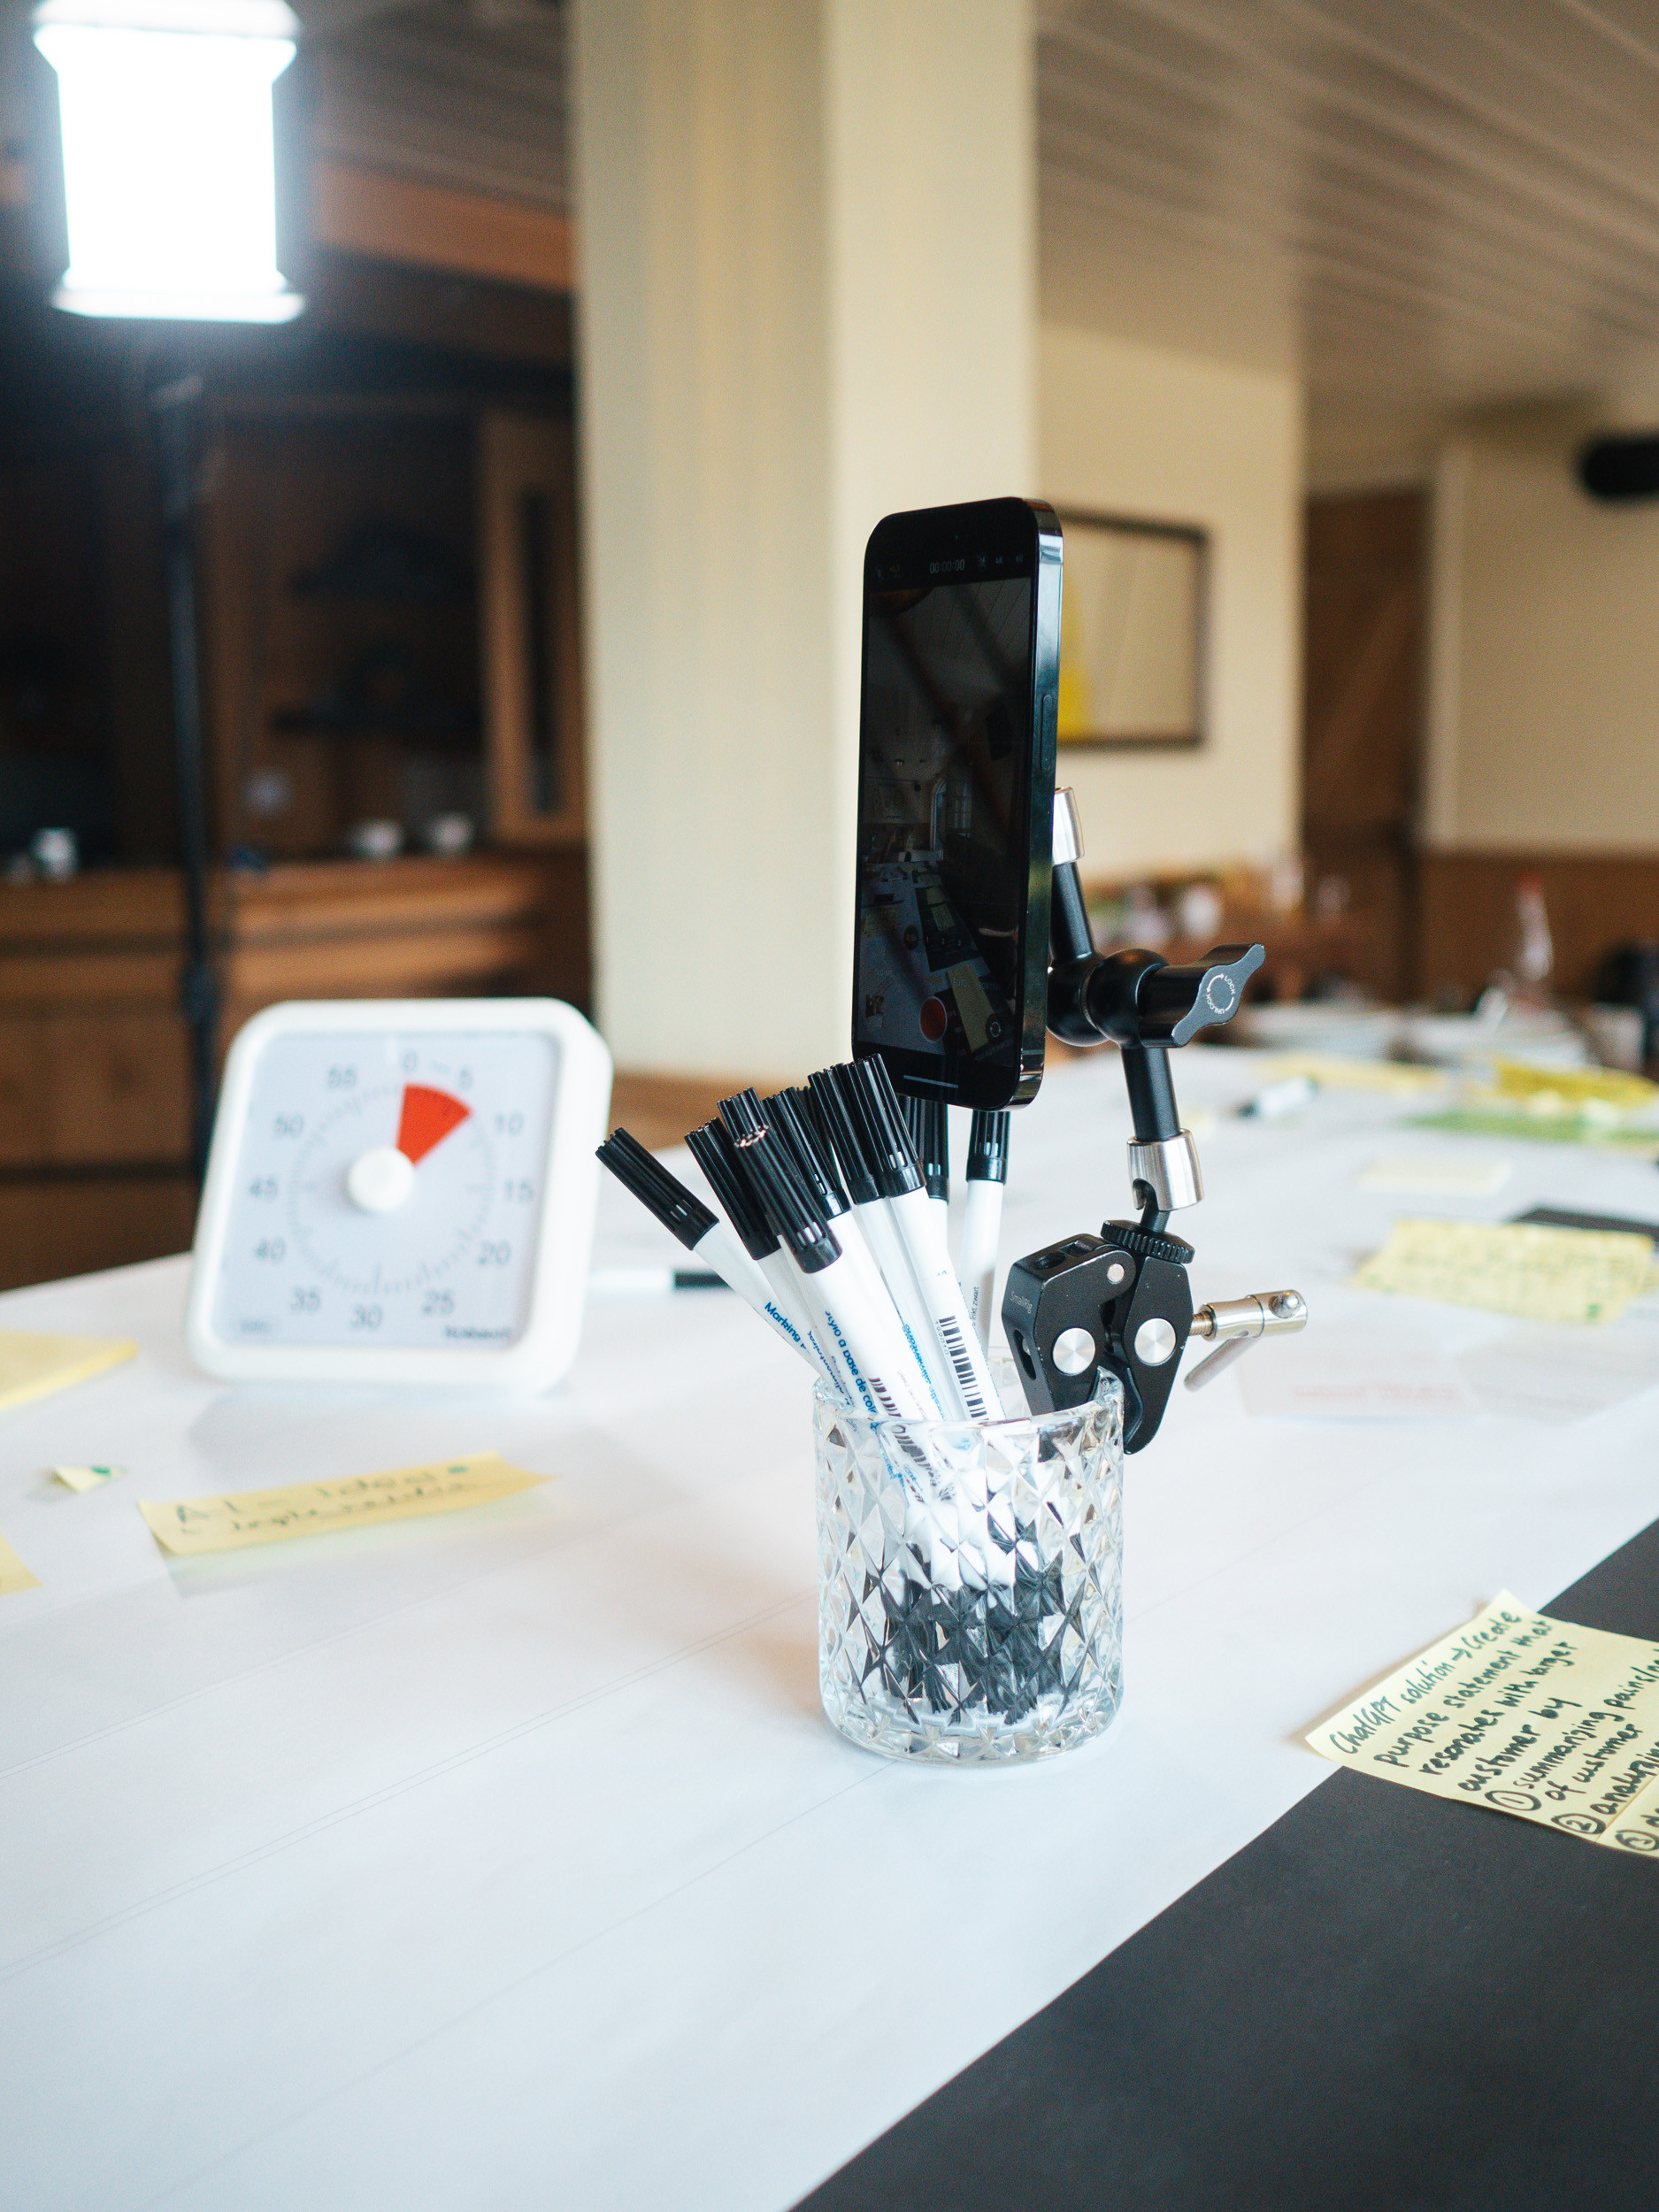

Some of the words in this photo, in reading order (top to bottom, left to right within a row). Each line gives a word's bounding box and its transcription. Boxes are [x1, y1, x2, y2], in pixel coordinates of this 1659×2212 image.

[1224, 975, 1236, 995] LOCK
[403, 1051, 419, 1071] 0
[326, 1067, 358, 1090] 55
[458, 1068, 472, 1089] 5
[273, 1113, 304, 1139] 50
[494, 1112, 524, 1135] 10
[249, 1177, 279, 1199] 45
[504, 1180, 534, 1202] 15
[254, 1239, 286, 1262] 40
[478, 1241, 511, 1266] 20
[289, 1287, 322, 1313] 35
[422, 1289, 456, 1316] 25
[350, 1305, 382, 1330] 30
[764, 1302, 801, 1342] Marking
[856, 1378, 866, 1393] de
[1329, 1695, 1402, 1755] ChatGPT
[1400, 1660, 1456, 1704] solution
[1373, 1712, 1450, 1768] purpose
[1442, 1649, 1523, 1709] statement
[1418, 1709, 1506, 1776] resonates
[1494, 1679, 1540, 1708] with
[1457, 1724, 1540, 1792] customer
[1527, 1697, 1583, 1720] by
[1545, 1780, 1586, 1801] of
[1571, 1724, 1643, 1783] customer
